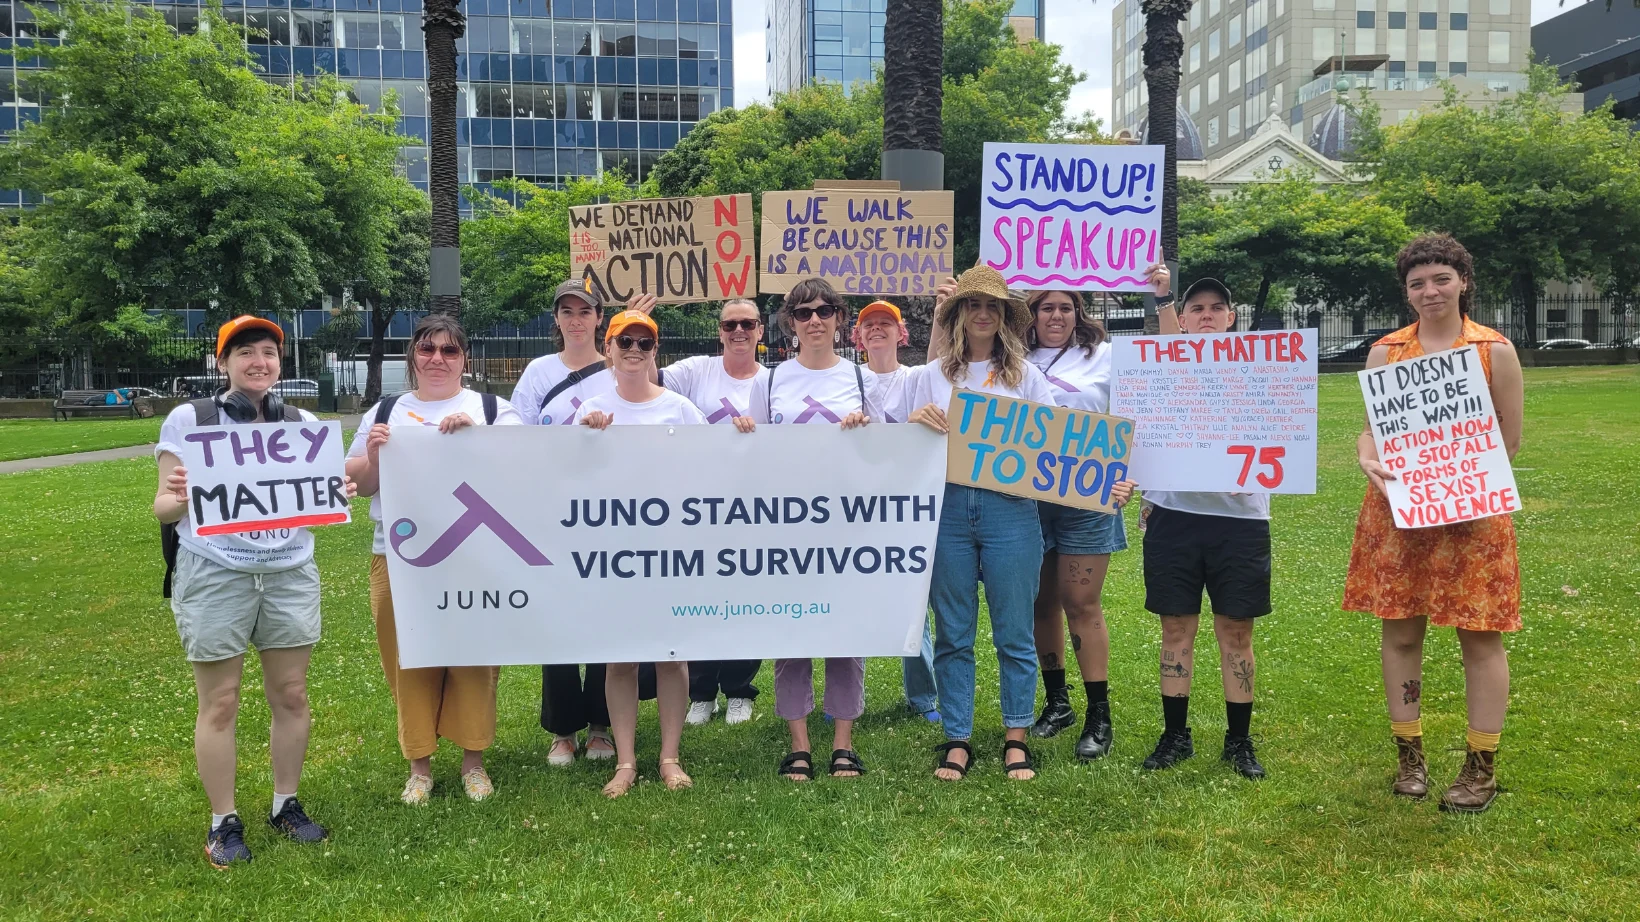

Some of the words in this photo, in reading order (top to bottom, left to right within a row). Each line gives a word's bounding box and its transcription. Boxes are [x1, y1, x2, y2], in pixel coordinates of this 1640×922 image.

[992, 152, 1098, 192] STAND
[1102, 163, 1156, 202] UP!
[570, 206, 605, 229] WE
[613, 200, 693, 227] DEMAND
[786, 196, 828, 225] WE
[848, 197, 914, 222] WALK
[573, 232, 579, 245] 1
[581, 231, 591, 244] IS
[581, 242, 599, 252] TOO
[609, 222, 703, 252] NATIONAL
[782, 227, 888, 252] BECAUSE
[893, 223, 949, 249] THIS
[987, 216, 1102, 271] SPEAK
[575, 249, 606, 263] MANY!
[768, 253, 787, 274] IS
[797, 256, 811, 274] A
[820, 251, 952, 277] NATIONAL
[582, 248, 708, 303] ACTION
[844, 275, 935, 295] CRISIS!
[1132, 338, 1206, 364] THEY
[1212, 331, 1308, 363] MATTER
[1118, 377, 1148, 385] REBEKAH
[1200, 376, 1220, 384] JANET
[1367, 370, 1386, 397] IT
[1395, 348, 1471, 390] DOESN'T
[1231, 398, 1256, 406] JESSICA
[1373, 392, 1418, 420] HAVE
[1420, 388, 1440, 405] TO
[1444, 378, 1469, 399] BE
[957, 392, 1054, 449] THIS
[1060, 413, 1132, 460] HAS
[1376, 416, 1409, 437] THIS
[1383, 425, 1444, 455] ACTION
[1451, 415, 1494, 437] NOW
[184, 426, 329, 468] THEY
[968, 442, 1026, 485] TO
[1385, 456, 1406, 471] TO
[1417, 441, 1460, 466] STOP
[1464, 434, 1498, 454] ALL
[1227, 445, 1286, 489] 75
[1402, 461, 1457, 485] FORMS
[1460, 457, 1481, 473] OF
[191, 476, 349, 526] MATTER
[1409, 471, 1489, 505] SEXIST
[560, 497, 671, 529] JUNO
[681, 495, 830, 526] STANDS
[840, 494, 937, 523] WITH
[1398, 488, 1515, 527] VIOLENCE
[226, 553, 255, 562] Support
[571, 549, 704, 579] VICTIM
[716, 545, 928, 577] SURVIVORS
[437, 589, 530, 611] JUNO
[671, 600, 831, 620] www.juno.org.au
